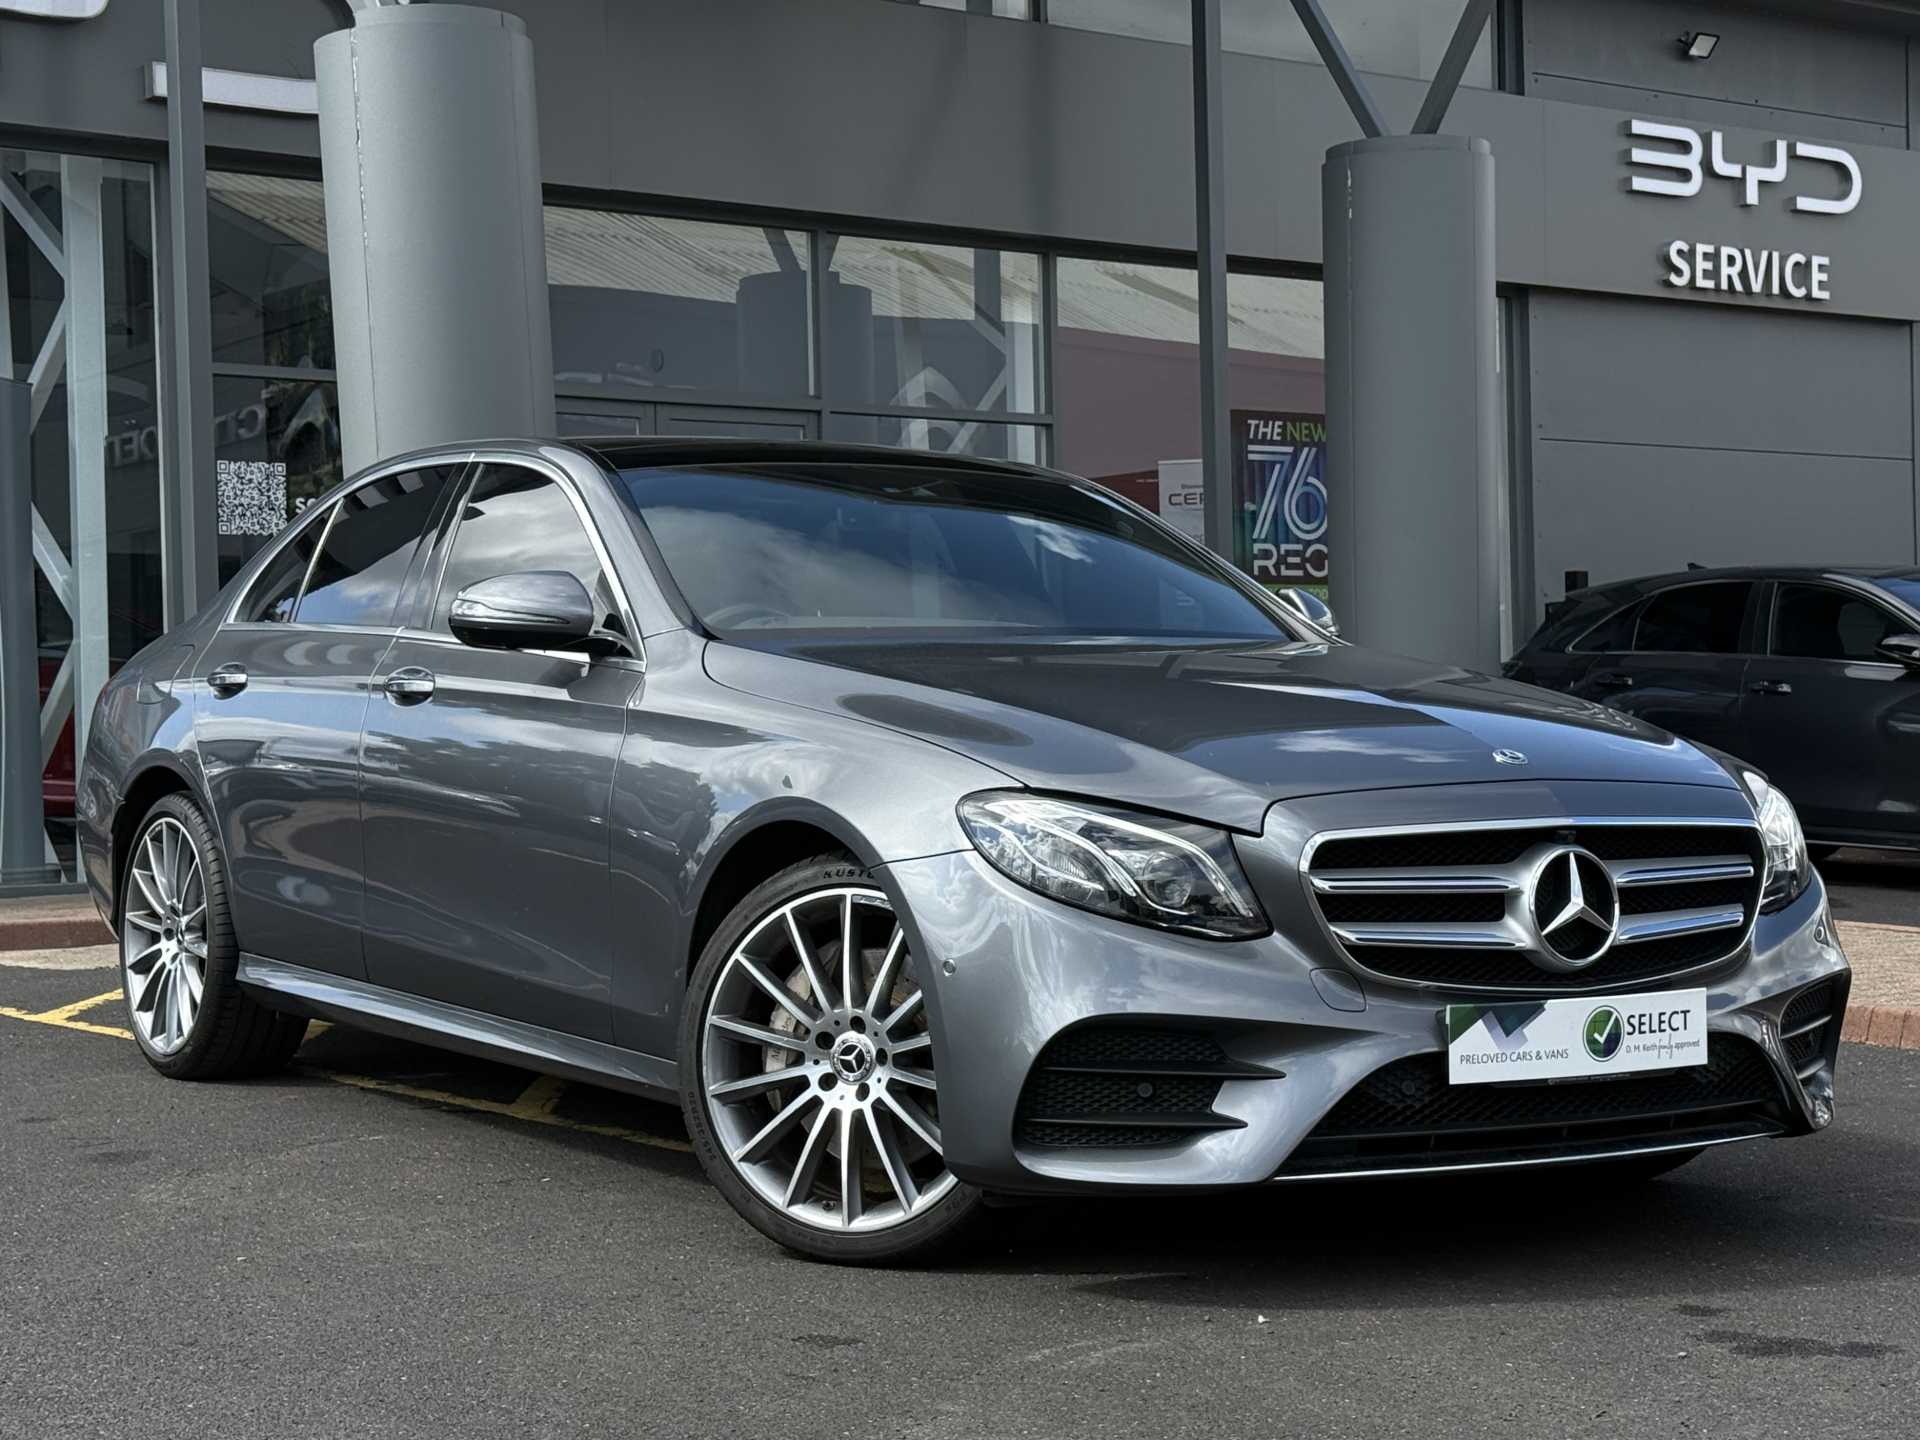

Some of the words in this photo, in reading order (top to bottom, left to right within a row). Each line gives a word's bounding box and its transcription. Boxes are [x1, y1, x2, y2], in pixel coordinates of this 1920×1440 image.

[1627, 119, 1863, 214] BYD
[1666, 240, 1831, 300] SERVICE
[1248, 420, 1283, 441] THE
[1287, 423, 1328, 442] NEW
[1248, 445, 1329, 541] 76
[1626, 1009, 1691, 1036] SELECT
[1460, 1052, 1508, 1065] PRELOVED
[1509, 1051, 1533, 1063] CARS
[1535, 1050, 1543, 1061] &
[1544, 1048, 1569, 1060] VANS
